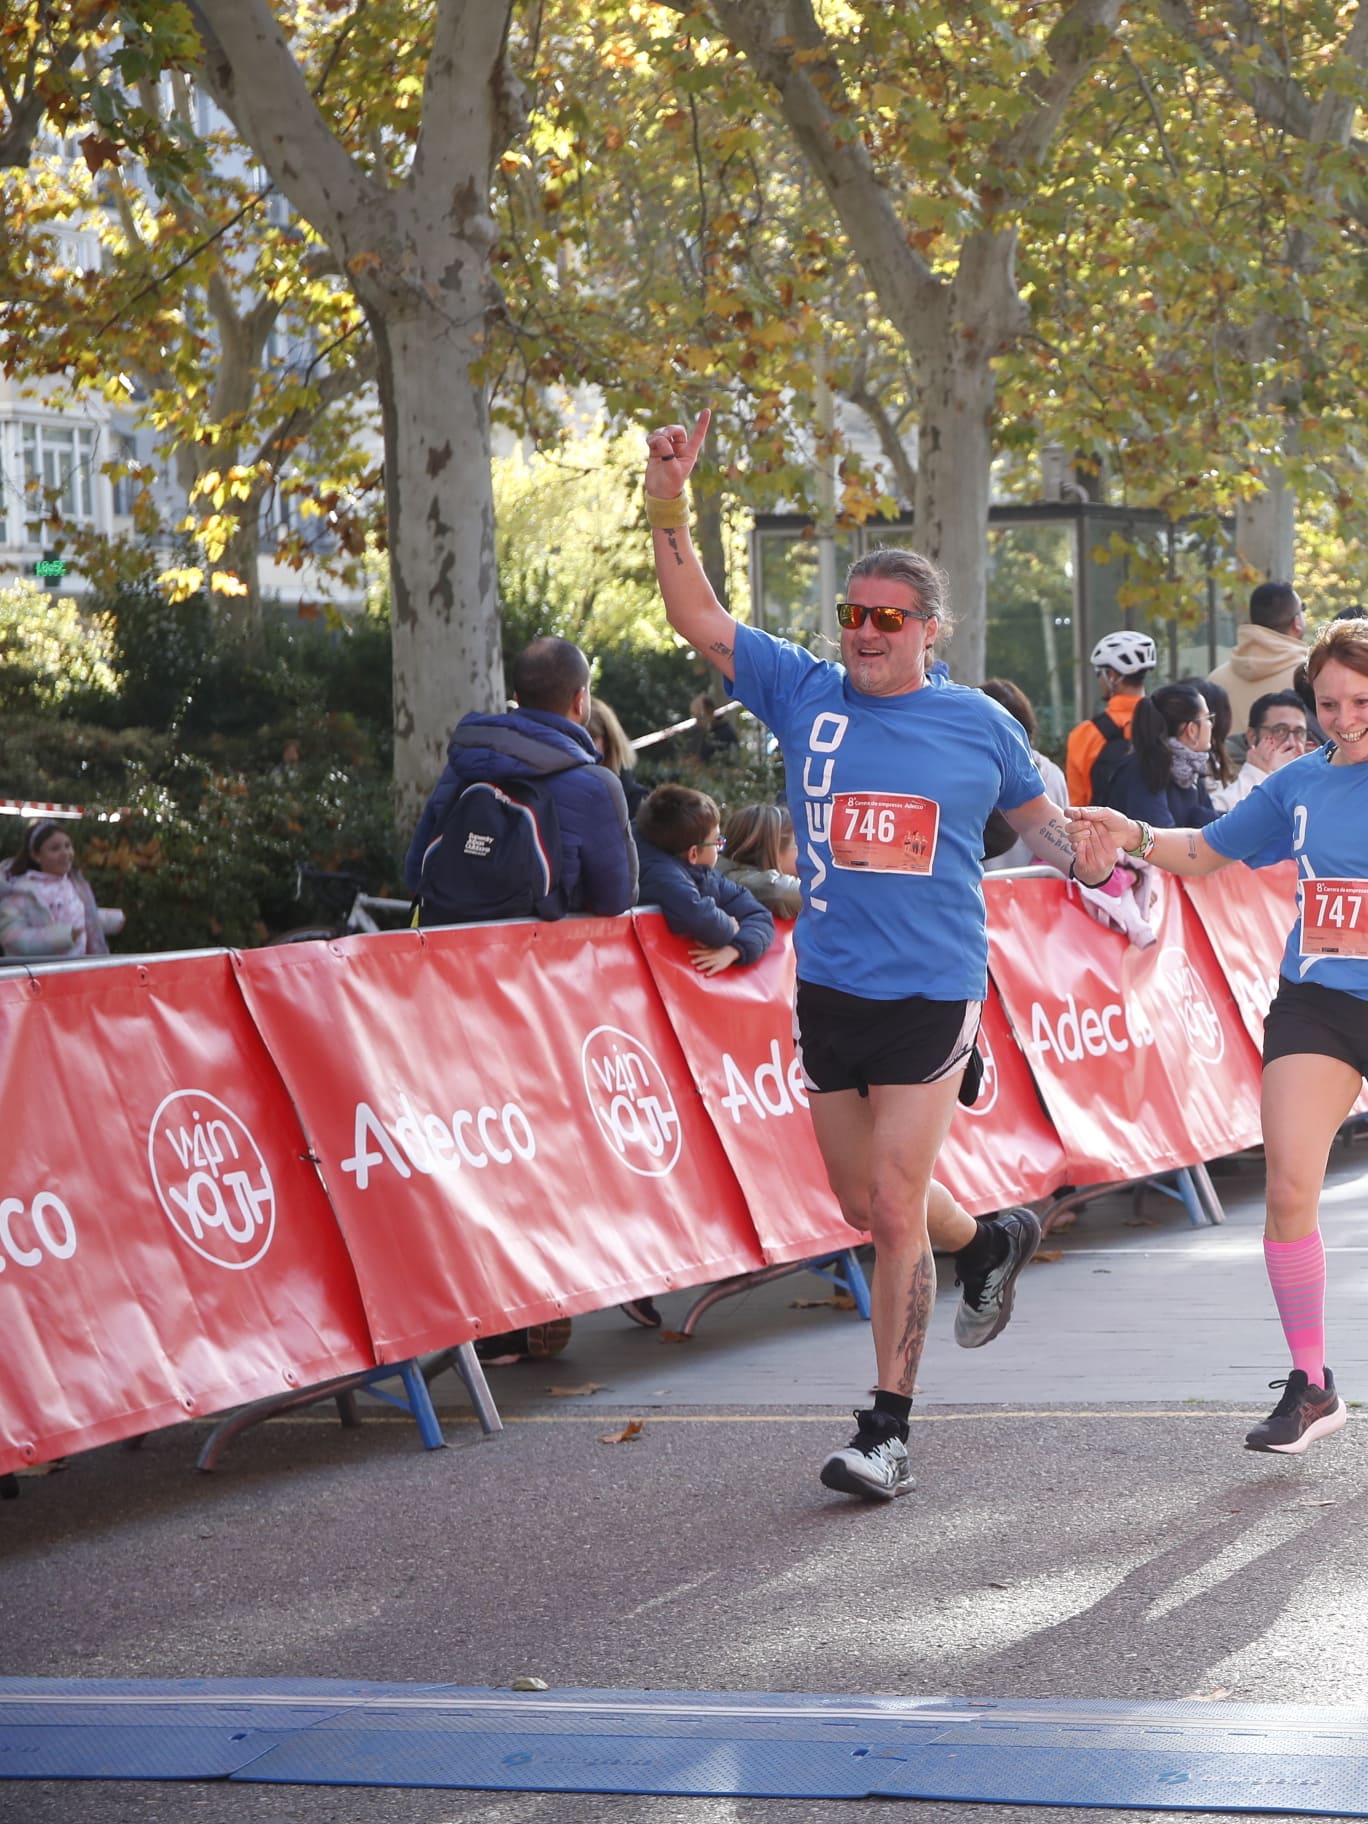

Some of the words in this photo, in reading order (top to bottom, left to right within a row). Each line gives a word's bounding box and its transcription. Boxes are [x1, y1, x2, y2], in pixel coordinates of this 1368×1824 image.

[803, 711, 849, 912] IVECO
[844, 808, 896, 843] 746
[1315, 894, 1362, 929] 747
[340, 1092, 536, 1190] Adecco
[598, 1091, 679, 1157] YOUTH
[168, 1166, 274, 1244] YOUTH
